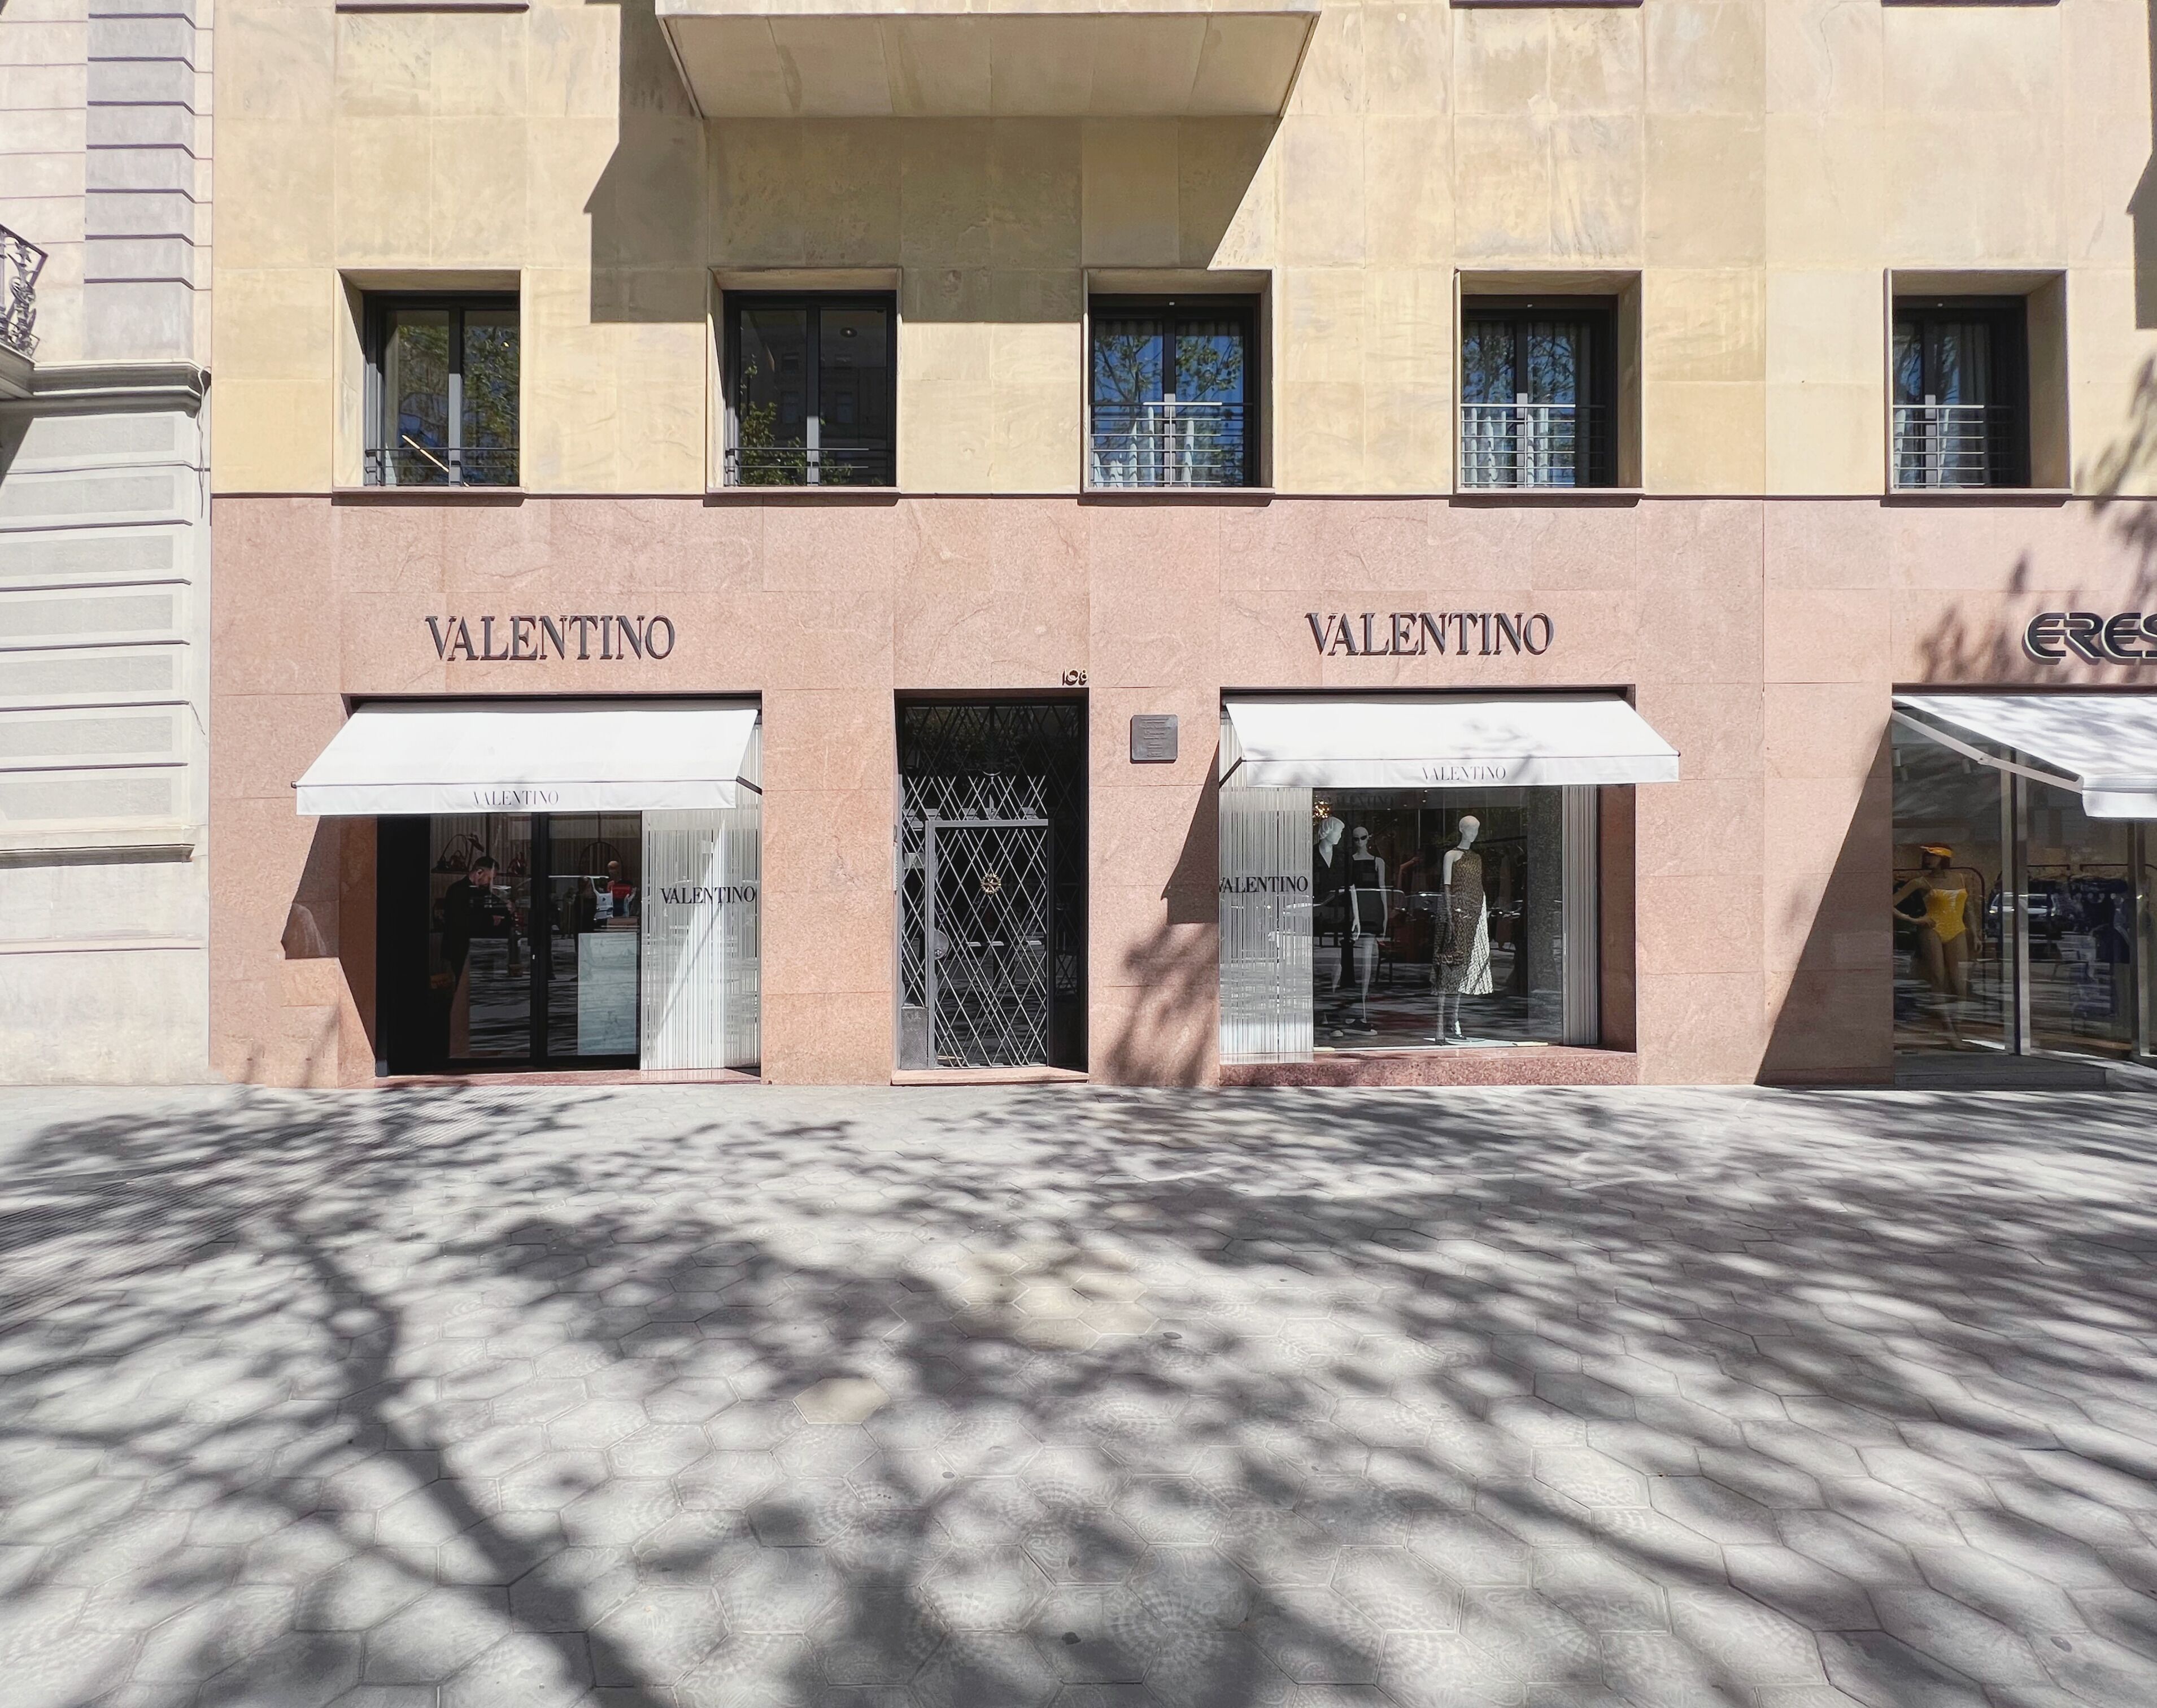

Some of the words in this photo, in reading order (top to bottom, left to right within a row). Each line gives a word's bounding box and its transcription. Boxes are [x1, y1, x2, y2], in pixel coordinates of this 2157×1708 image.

[425, 615, 675, 660] VALENTINO
[1304, 612, 1554, 655] VALENTINO
[1062, 669, 1088, 685] 108
[1422, 765, 1506, 781] VALENTINO
[474, 790, 559, 805] VALENTINO
[660, 886, 756, 904] VALENTINO
